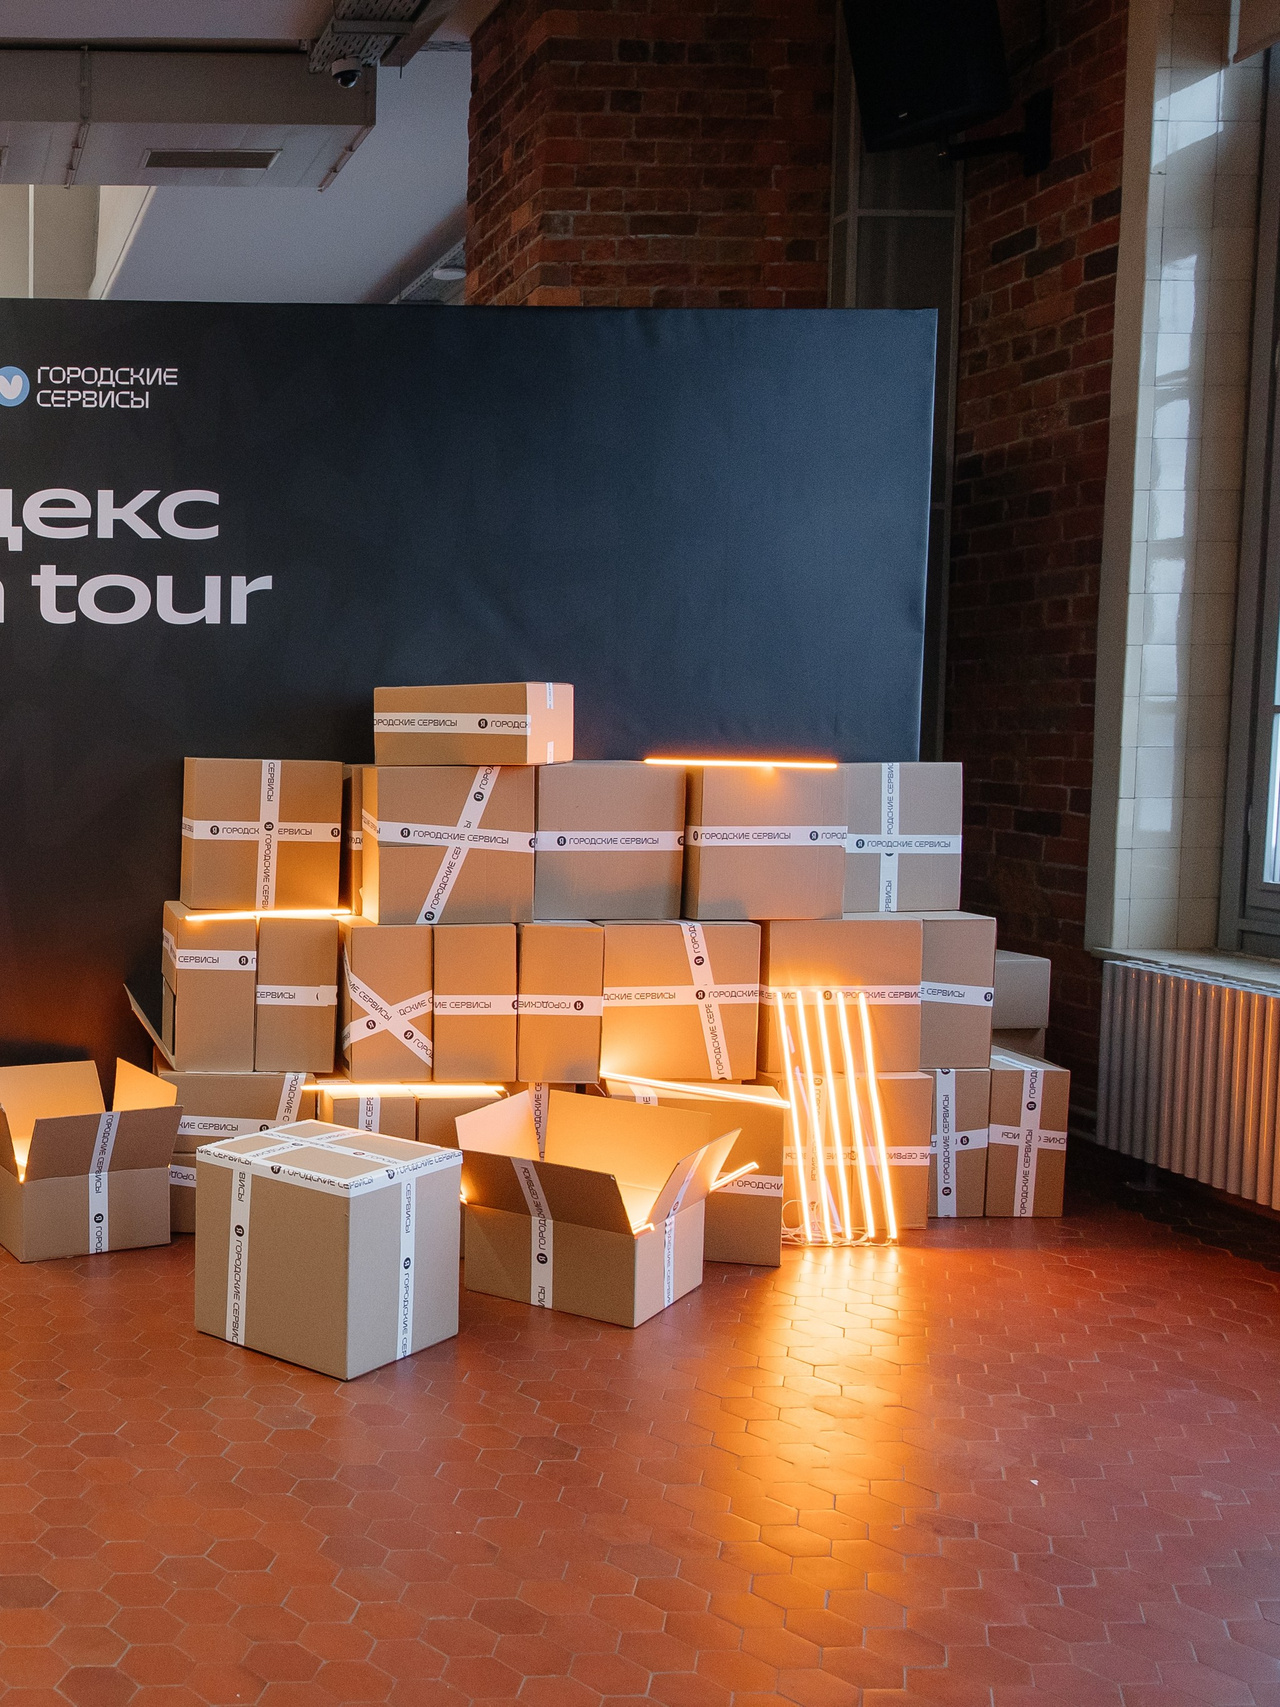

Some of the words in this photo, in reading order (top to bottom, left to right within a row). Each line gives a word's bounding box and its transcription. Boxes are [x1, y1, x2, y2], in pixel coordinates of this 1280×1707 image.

[37, 366, 178, 388] ГОРОДСКИЕ
[36, 390, 150, 408] СЕРВИСЫ
[31, 565, 273, 625] tour
[418, 718, 458, 727] СЕРВИСЫ
[278, 828, 312, 836] ЕРВИСЫ
[413, 830, 465, 841] ГОРОДСКИЕ
[467, 834, 510, 844] СЕРВИСЫ
[568, 836, 618, 846] ГОРОДСКИЕ
[620, 836, 659, 846] СЕРВИСЫ
[700, 832, 750, 840] ГОРОДСКИЕ
[752, 832, 791, 840] СЕРВИСЫ
[867, 839, 914, 848] ГОРОДСКИЕ
[916, 840, 951, 848] СЕРВИСЫ
[263, 834, 272, 882] ГОРОДСКИЕ
[430, 860, 456, 910] ГОРОДСКИЕ
[178, 956, 220, 964] СЕРВИСЫ
[634, 992, 676, 1000] СЕРВИСЫ
[926, 988, 965, 998] СЕРВИСЫ
[358, 990, 392, 1022] СЕРВИСЫ
[397, 998, 427, 1017] ДСКИЕ
[449, 1001, 492, 1010] СЕРВИСЫ
[519, 1001, 571, 1010] ГОРОДСКИЕ
[708, 1025, 724, 1074] ГОРОДСКИЕ
[284, 1074, 298, 1114] РОДСКИЕ
[98, 1114, 114, 1156] ГОРОДСКИЕ
[198, 1122, 239, 1131] СЕРВИСЫ
[1023, 1128, 1033, 1170] СЕРВИСЫ
[95, 1157, 105, 1194] СЕРВИСЫ
[521, 1166, 540, 1202] СЕРВИСЫ
[533, 1201, 546, 1250] ГОРОДСКИЕ
[233, 1240, 242, 1300] ГОРОДСКИЕ
